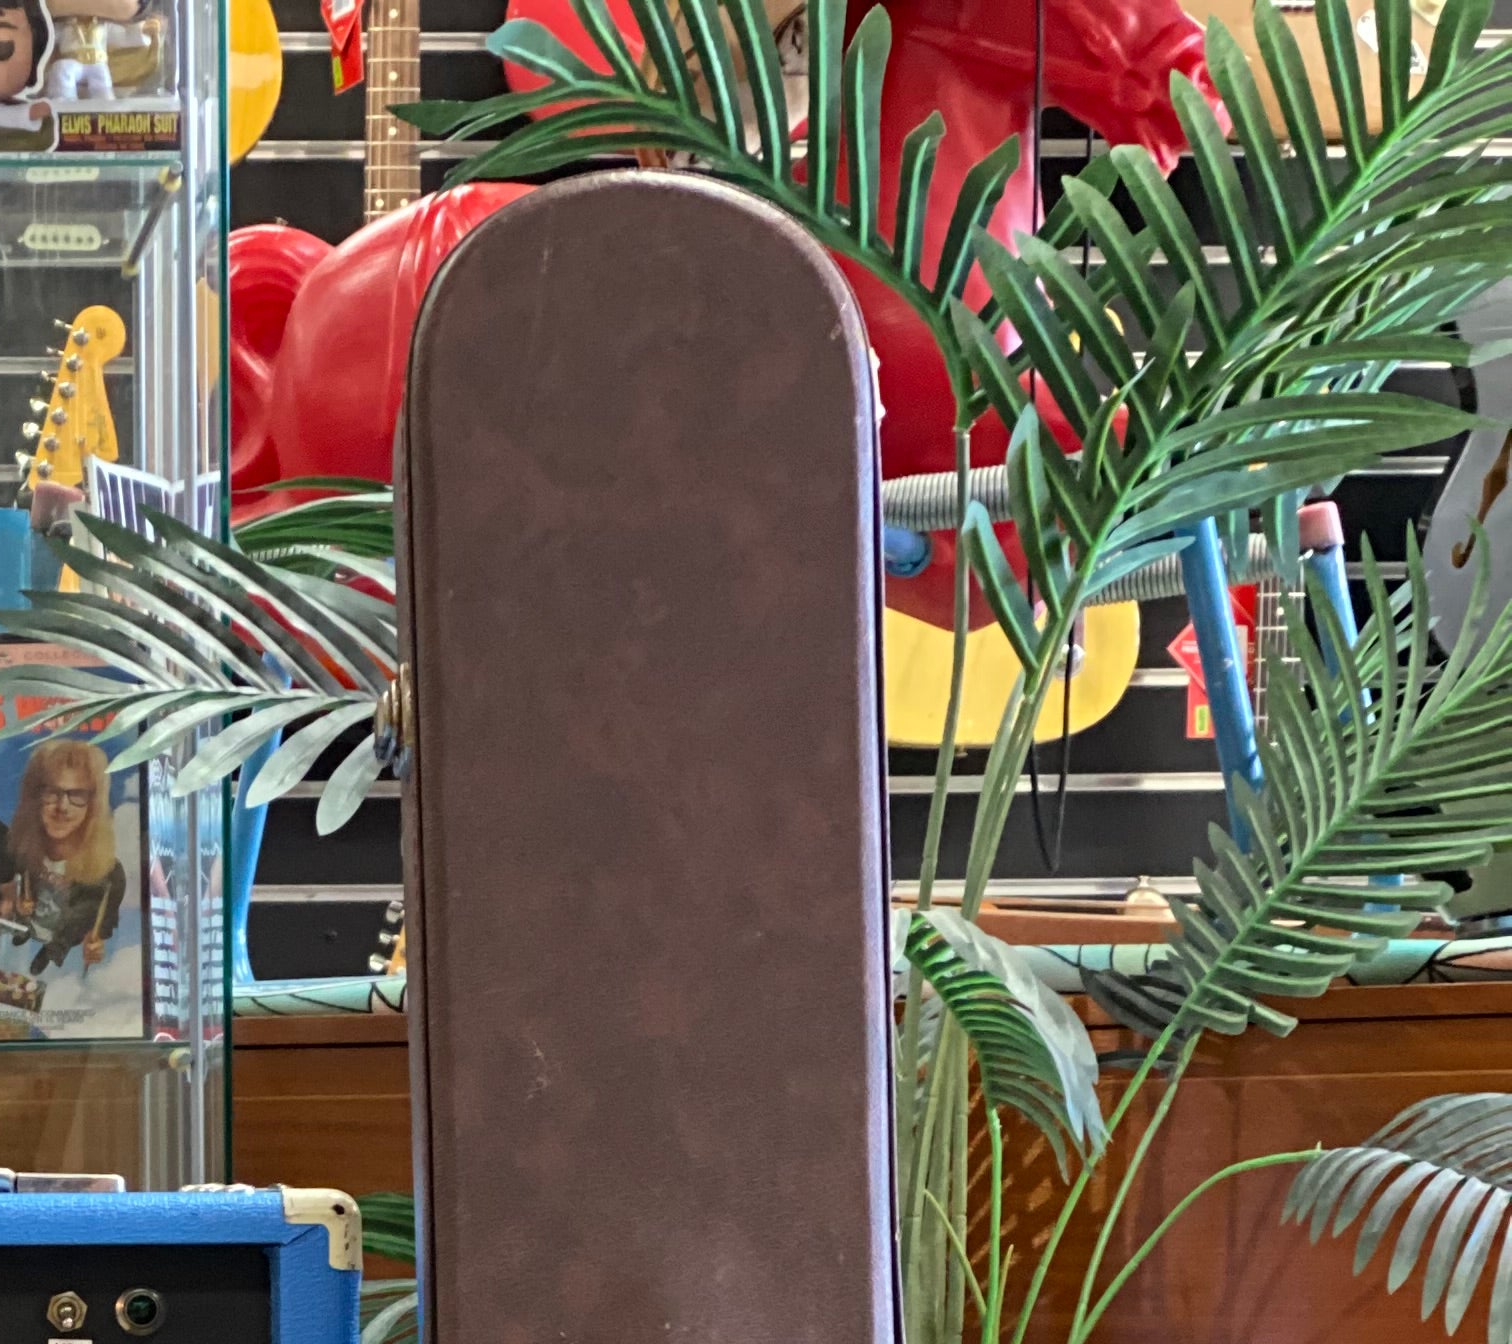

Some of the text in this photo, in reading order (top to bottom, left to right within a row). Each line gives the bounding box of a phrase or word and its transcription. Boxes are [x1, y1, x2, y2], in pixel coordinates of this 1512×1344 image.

[61, 112, 178, 135] ELVIS PHARAOH SUIT
